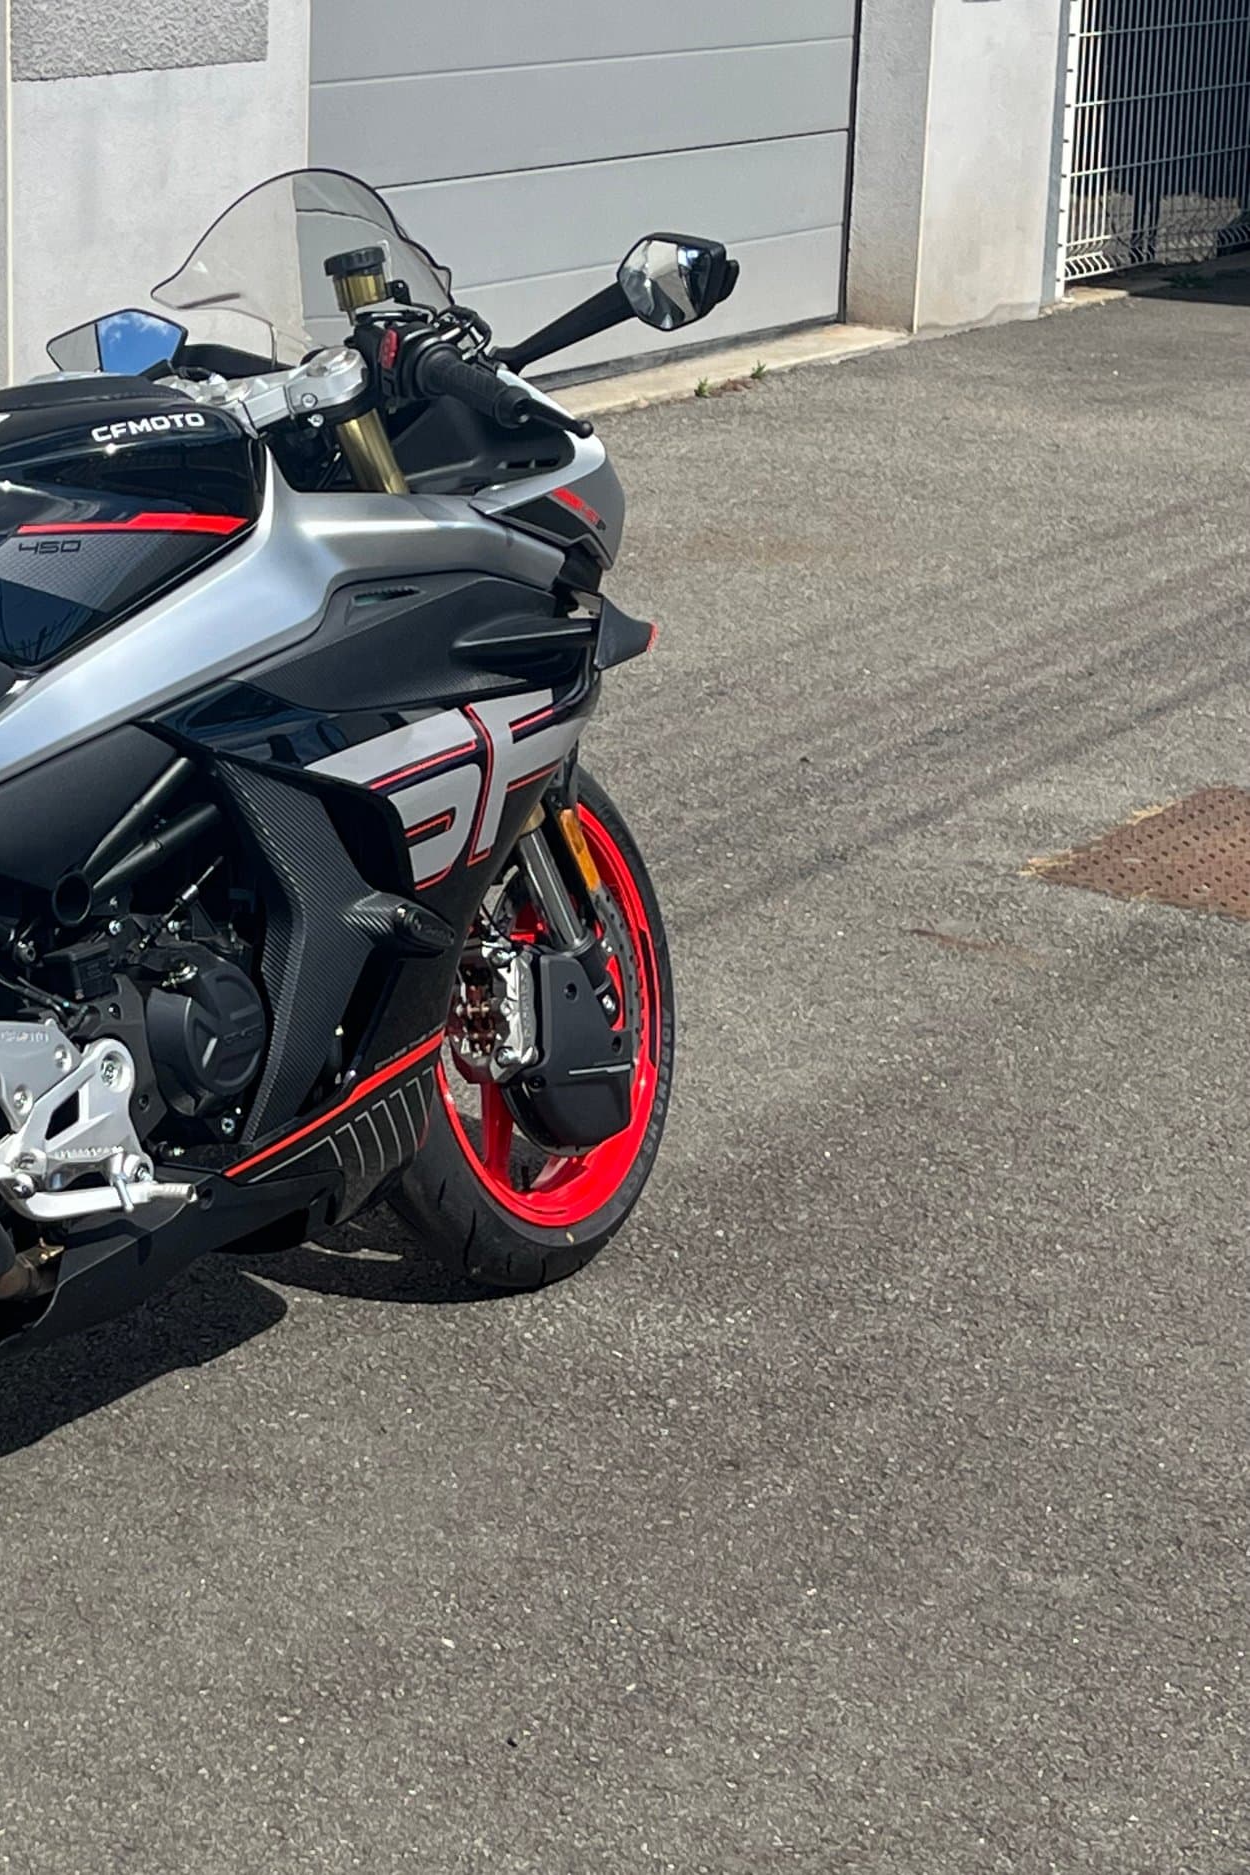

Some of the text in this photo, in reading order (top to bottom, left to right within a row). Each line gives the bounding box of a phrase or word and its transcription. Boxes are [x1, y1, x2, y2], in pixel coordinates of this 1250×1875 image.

[91, 412, 206, 443] CFMOTO
[18, 539, 82, 556] 450
[653, 1008, 672, 1116] ADRENO
